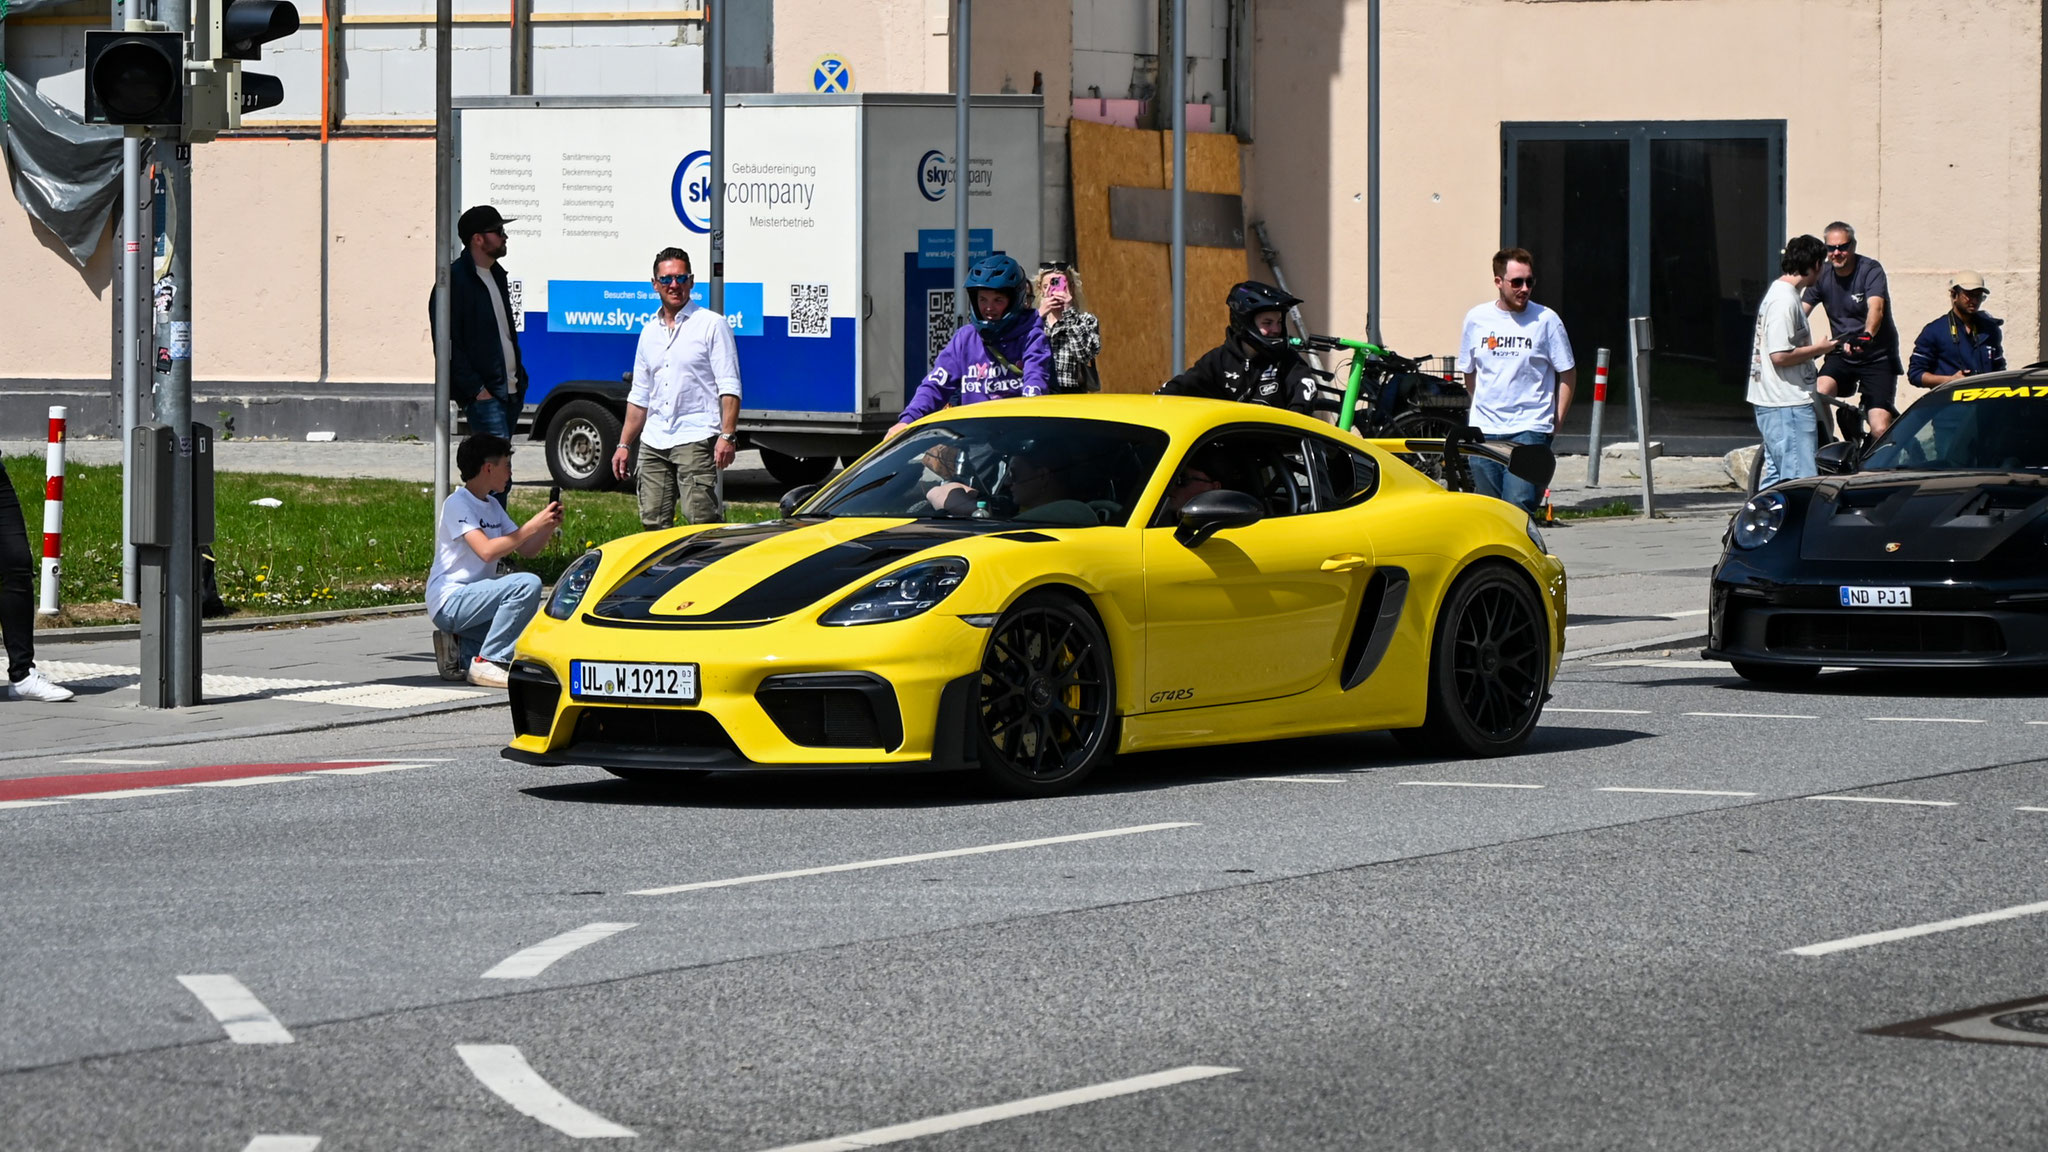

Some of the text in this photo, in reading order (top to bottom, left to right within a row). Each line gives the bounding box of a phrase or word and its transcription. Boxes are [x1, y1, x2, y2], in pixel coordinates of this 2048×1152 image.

[490, 152, 531, 163] Büroreinigung
[562, 152, 611, 163] Sanitärreinigung
[490, 168, 533, 178] Hotelreinigung
[562, 168, 613, 178] Deckenreinigung
[732, 162, 816, 177] Gebäudereinigung
[490, 182, 536, 193] Grundreinigung
[562, 183, 613, 194] Fensterreinigung
[688, 176, 815, 211] skcompany
[562, 213, 613, 224] Teppichreinigung
[749, 216, 815, 228] Meisterbetrieb
[562, 229, 620, 239] Fassadenreinigung
[603, 290, 636, 300] Besuchen
[636, 290, 648, 300] Sie
[961, 375, 982, 394] for
[1850, 590, 1870, 604] ND
[582, 666, 603, 691] UL
